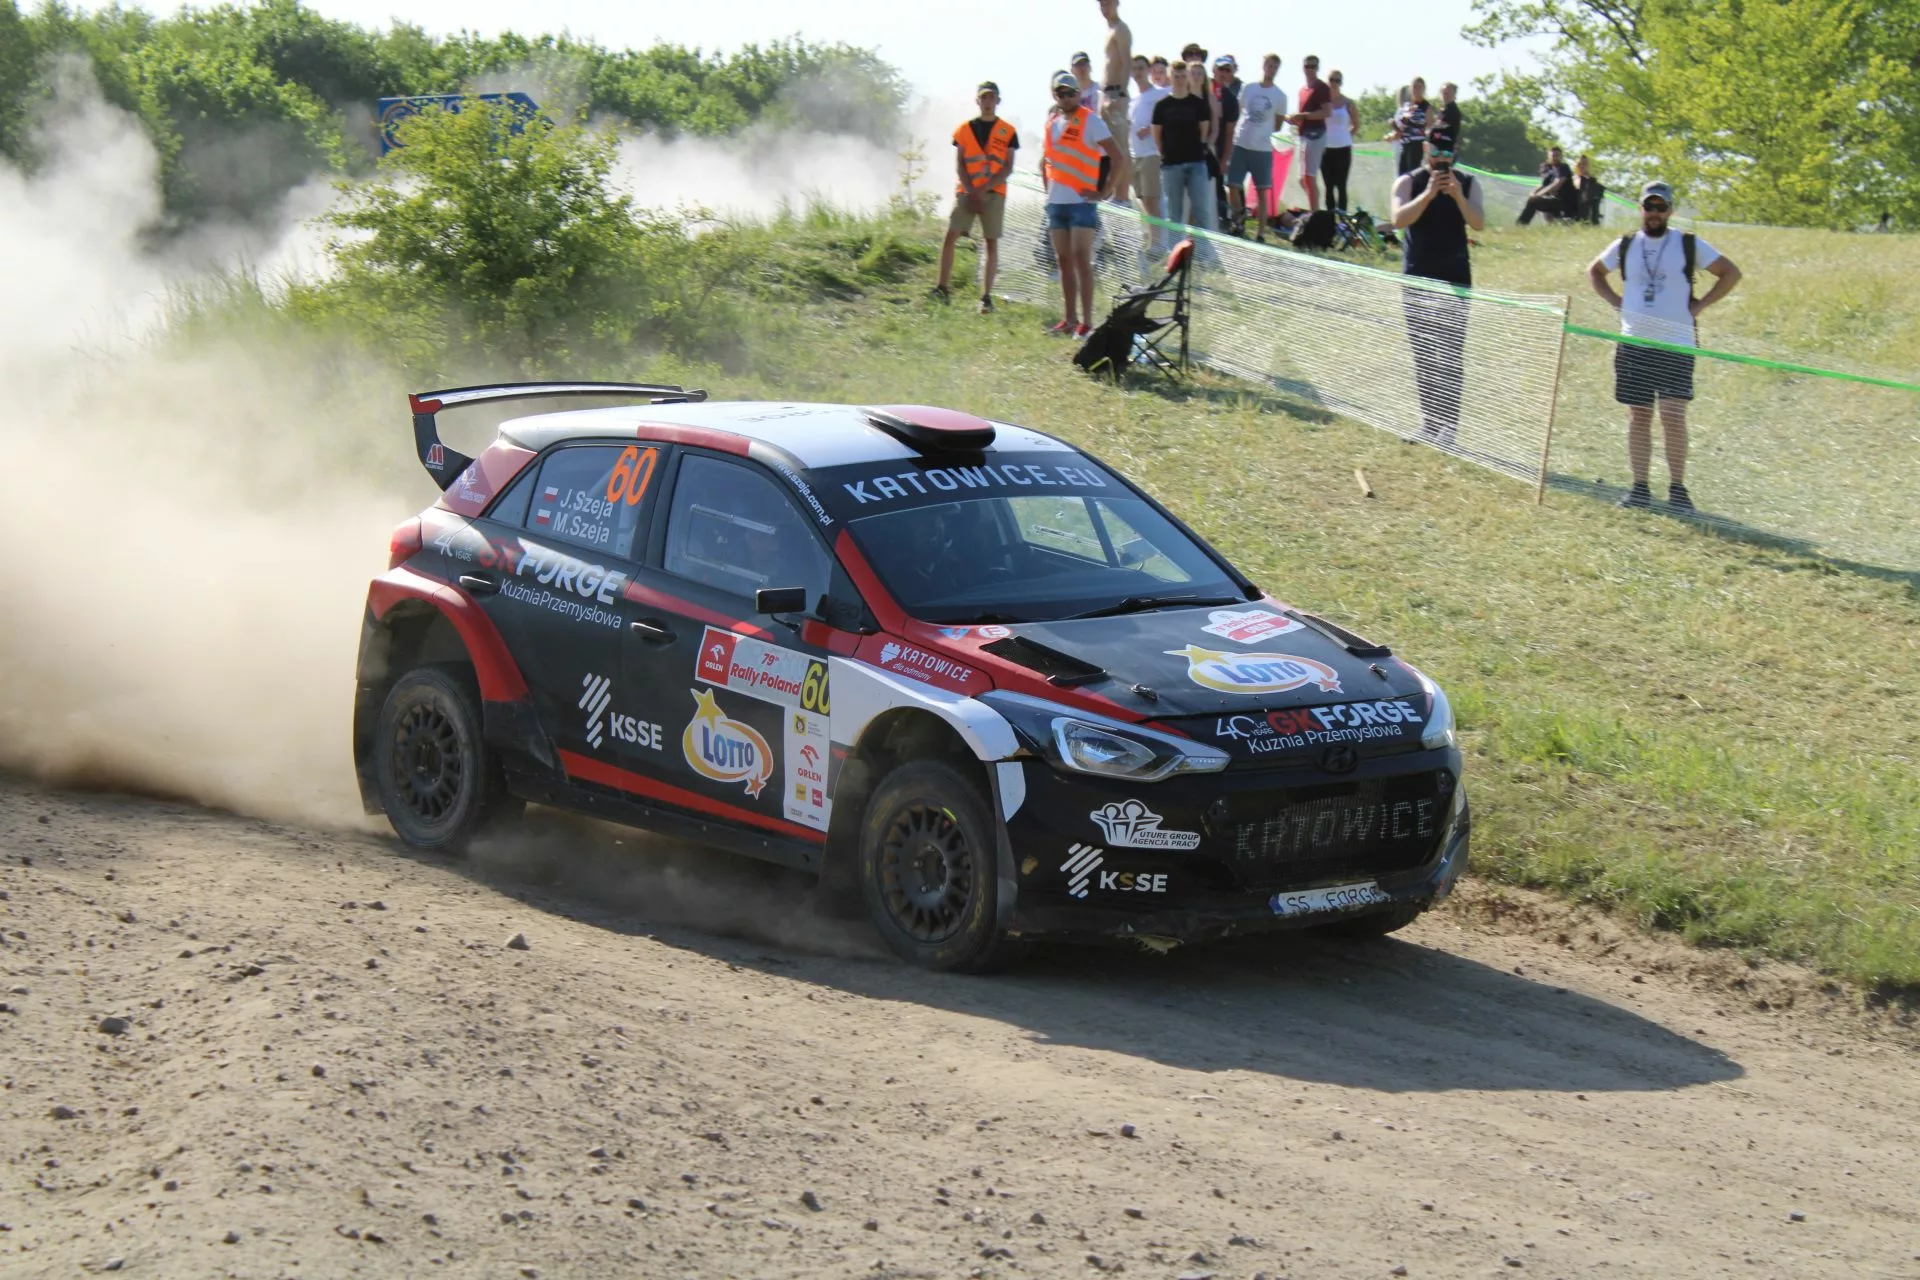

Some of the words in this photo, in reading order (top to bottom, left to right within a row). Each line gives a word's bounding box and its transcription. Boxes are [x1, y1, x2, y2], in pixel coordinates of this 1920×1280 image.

[607, 444, 657, 506] 60
[843, 464, 1106, 503] KATOWICE.EU
[560, 488, 614, 520] J.Szeja
[553, 511, 610, 543] M.Szeja
[705, 660, 724, 673] ORLEN
[730, 663, 760, 687] Rally
[760, 671, 802, 696] Poland
[900, 646, 972, 682] KATOWICE
[1211, 661, 1307, 684] LOTTO
[610, 711, 663, 751] KSSE
[702, 724, 755, 768] LOTTO
[1305, 723, 1402, 745] Przemysłowa
[797, 767, 822, 783] ORLEN
[1132, 838, 1169, 846] AGENCJA
[1169, 833, 1199, 841] GROUP
[1236, 799, 1434, 860] KATOWICE
[1100, 870, 1168, 893] KSSE
